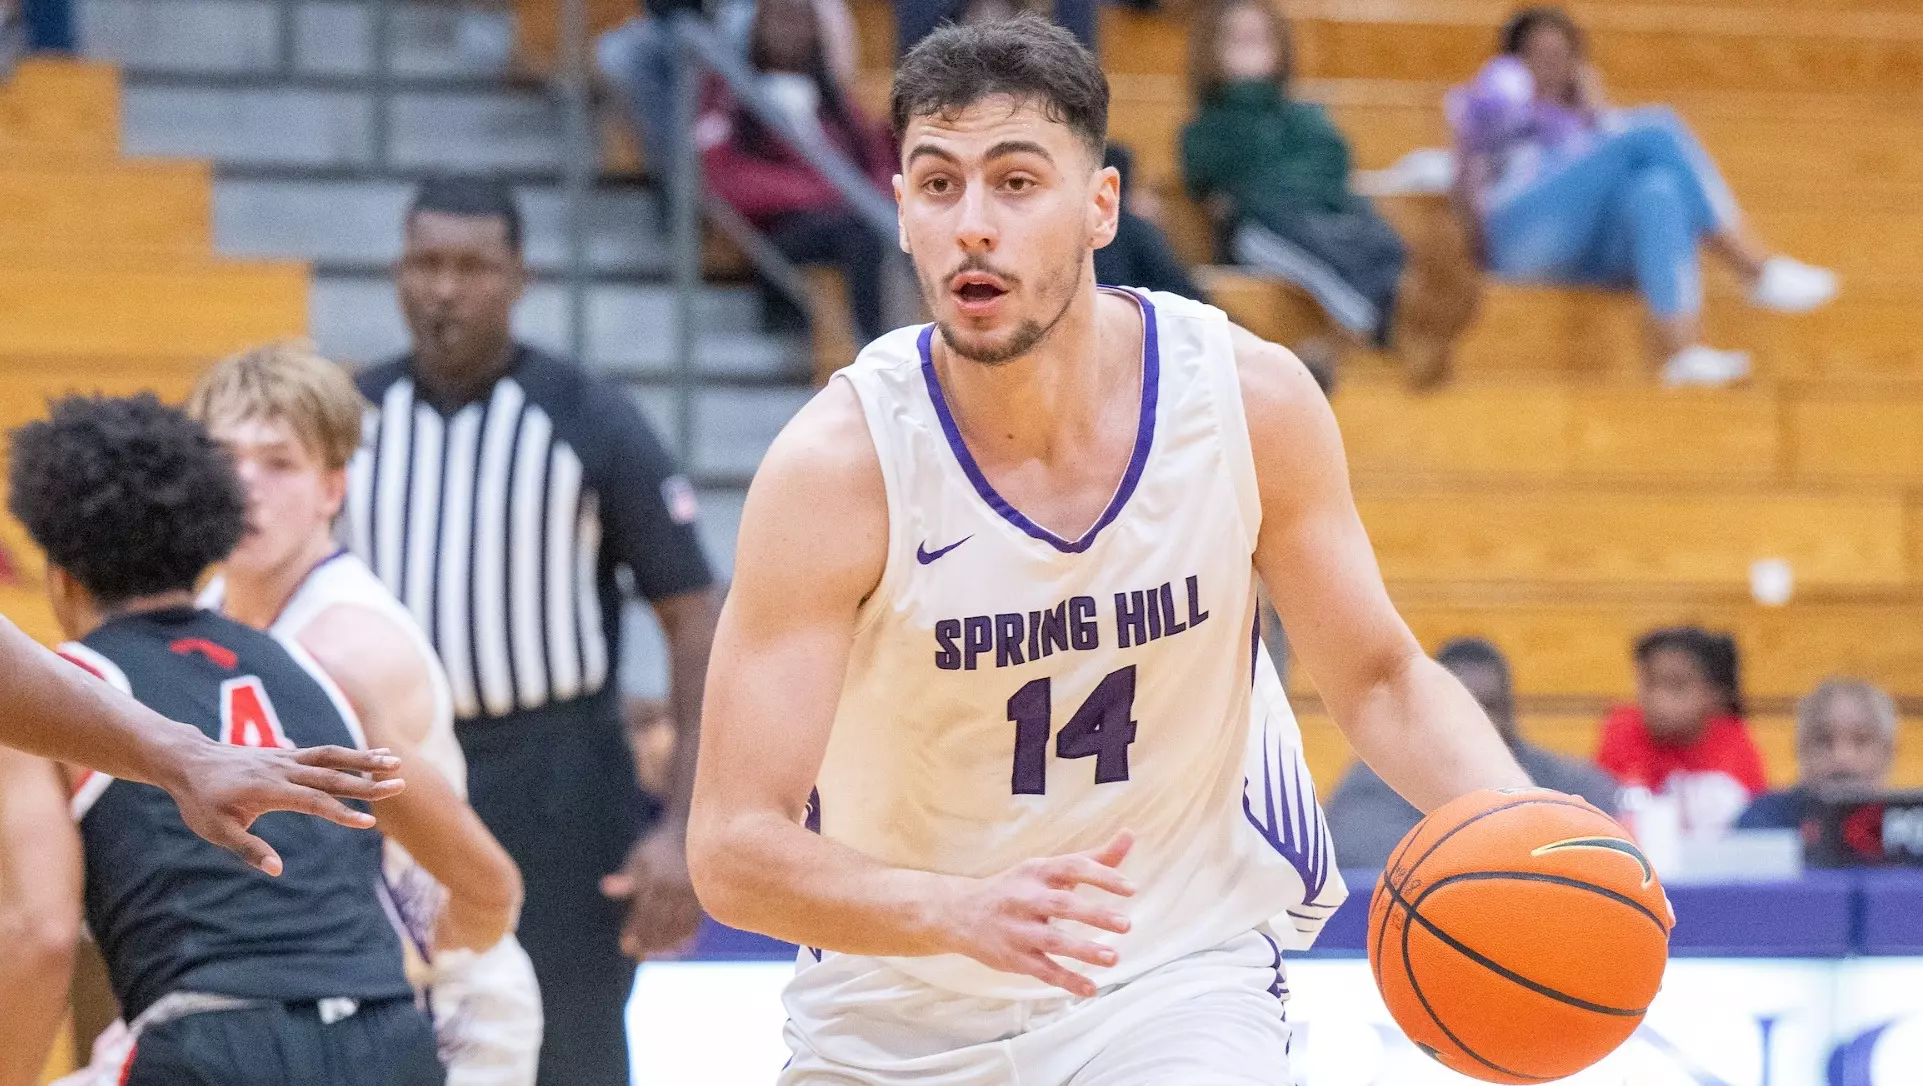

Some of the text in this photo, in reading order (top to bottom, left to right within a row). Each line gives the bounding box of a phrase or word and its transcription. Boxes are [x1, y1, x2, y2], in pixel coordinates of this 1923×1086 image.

[935, 574, 1210, 670] SPRING HILL
[1007, 664, 1138, 795] 14
